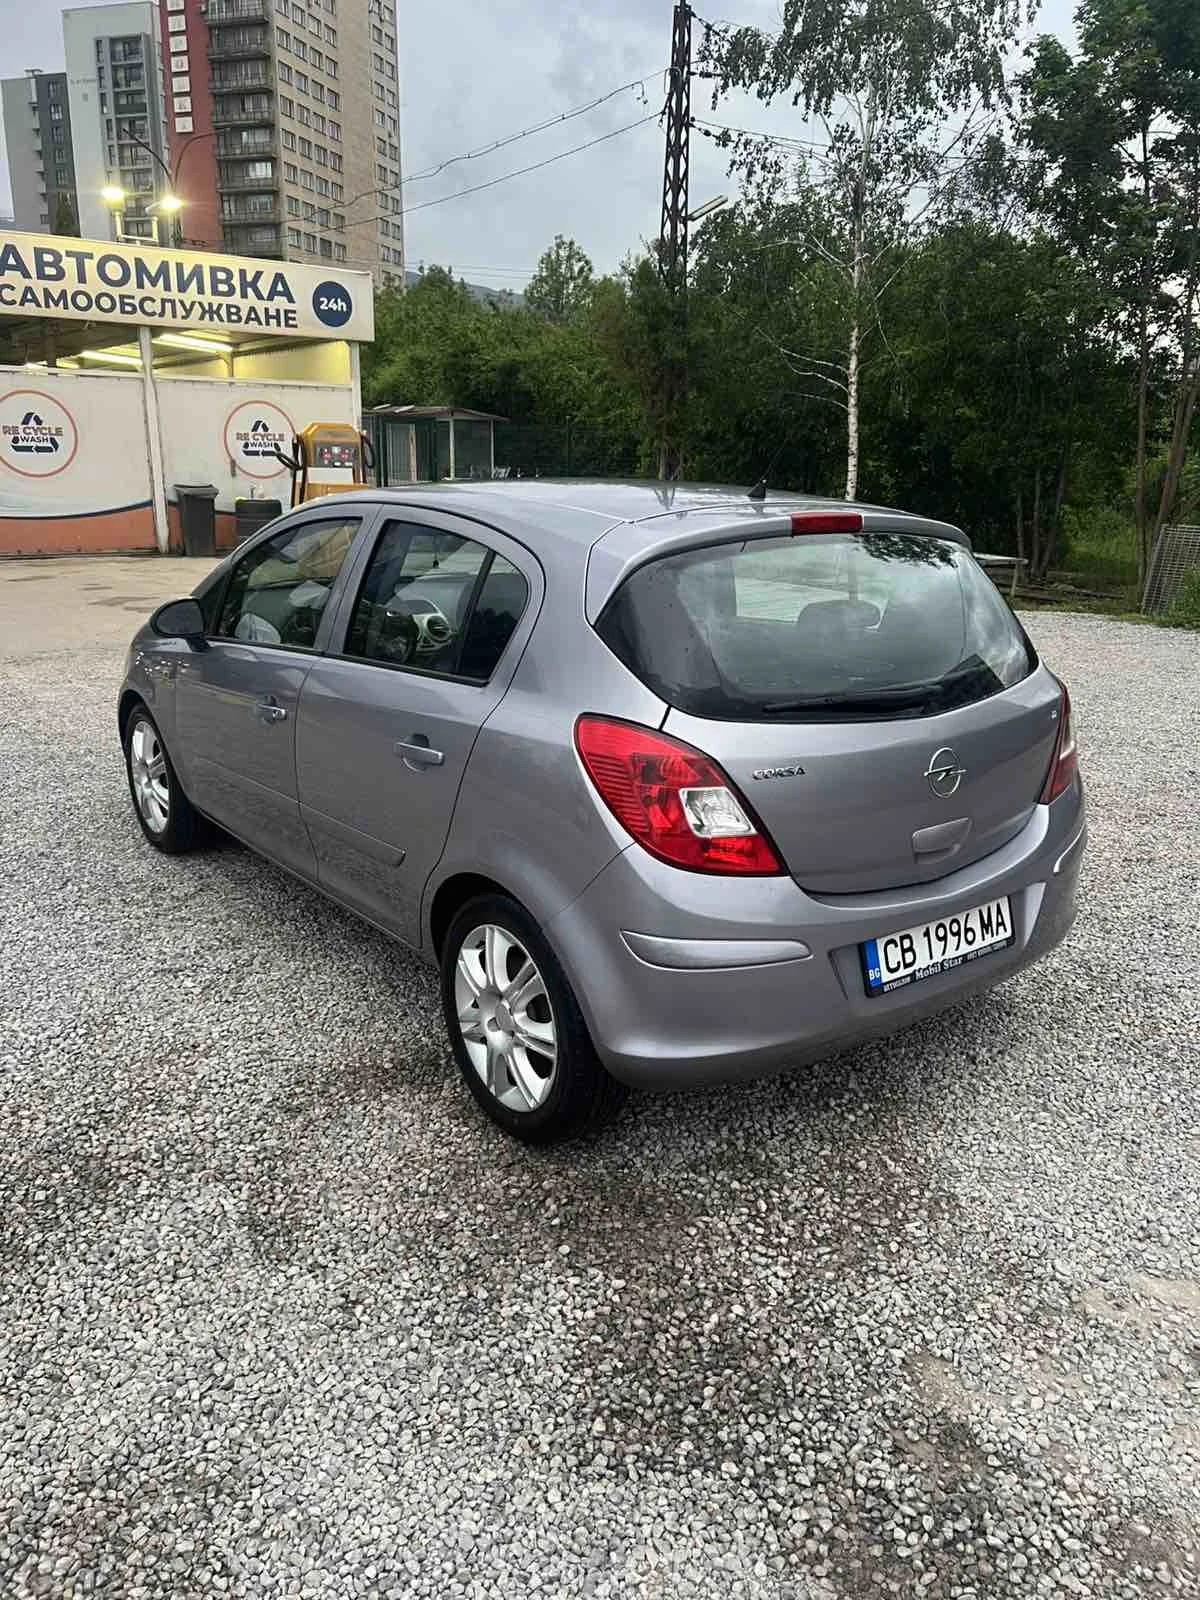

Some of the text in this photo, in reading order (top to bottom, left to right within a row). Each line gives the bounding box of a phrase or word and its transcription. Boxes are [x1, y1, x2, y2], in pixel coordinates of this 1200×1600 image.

[0, 243, 295, 304] АВТОМИВКА
[0, 283, 298, 328] САМООБСЛУЖВАНЕ
[319, 297, 347, 313] 24h
[2, 425, 63, 436] RE CYCLE
[236, 432, 285, 442] RE CYCLE
[20, 435, 49, 443] WASH
[250, 441, 273, 449] WASH
[752, 766, 806, 781] CORSA
[883, 933, 916, 974] CB
[923, 913, 976, 960] 1996
[978, 901, 1008, 941] MA
[868, 967, 881, 981] BG
[915, 955, 963, 981] Mobil Star
